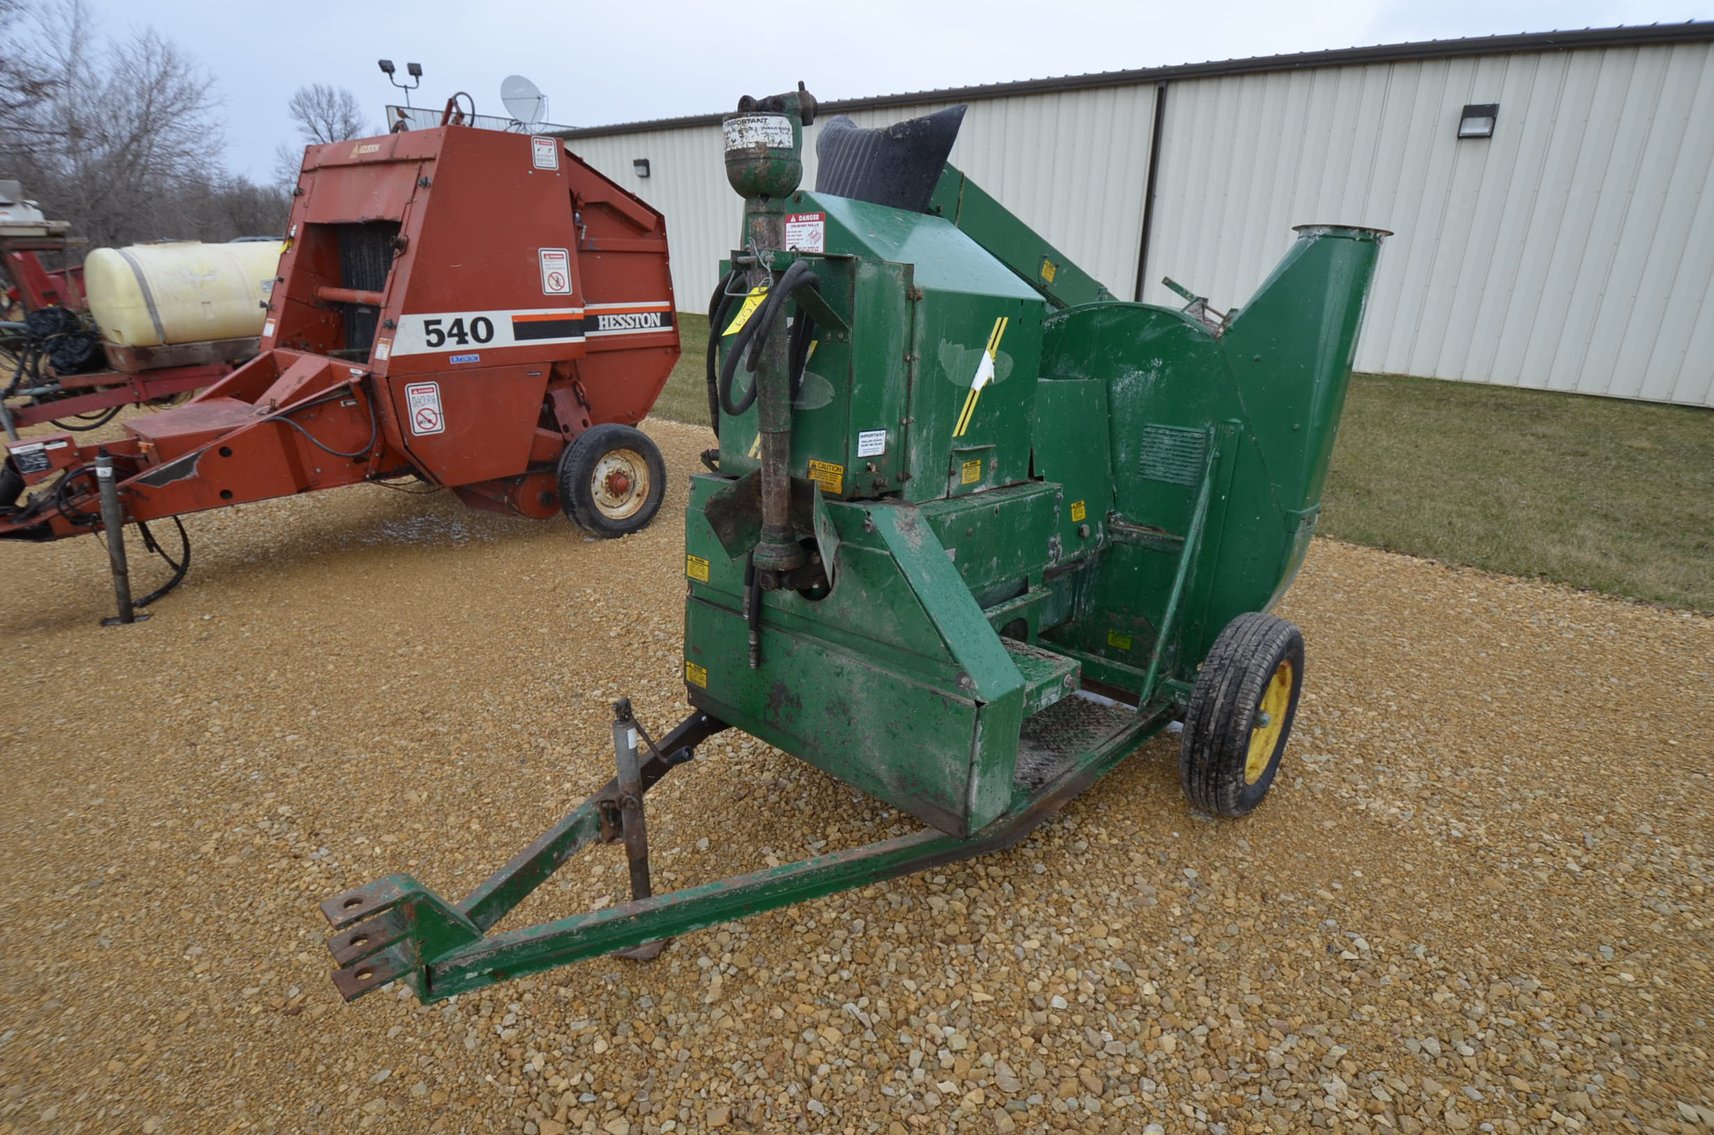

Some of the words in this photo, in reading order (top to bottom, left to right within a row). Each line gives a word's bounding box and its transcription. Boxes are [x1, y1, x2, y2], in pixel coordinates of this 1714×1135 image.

[598, 312, 661, 330] HESSTON
[424, 317, 494, 347] 540
[818, 463, 841, 472] CAUTION
